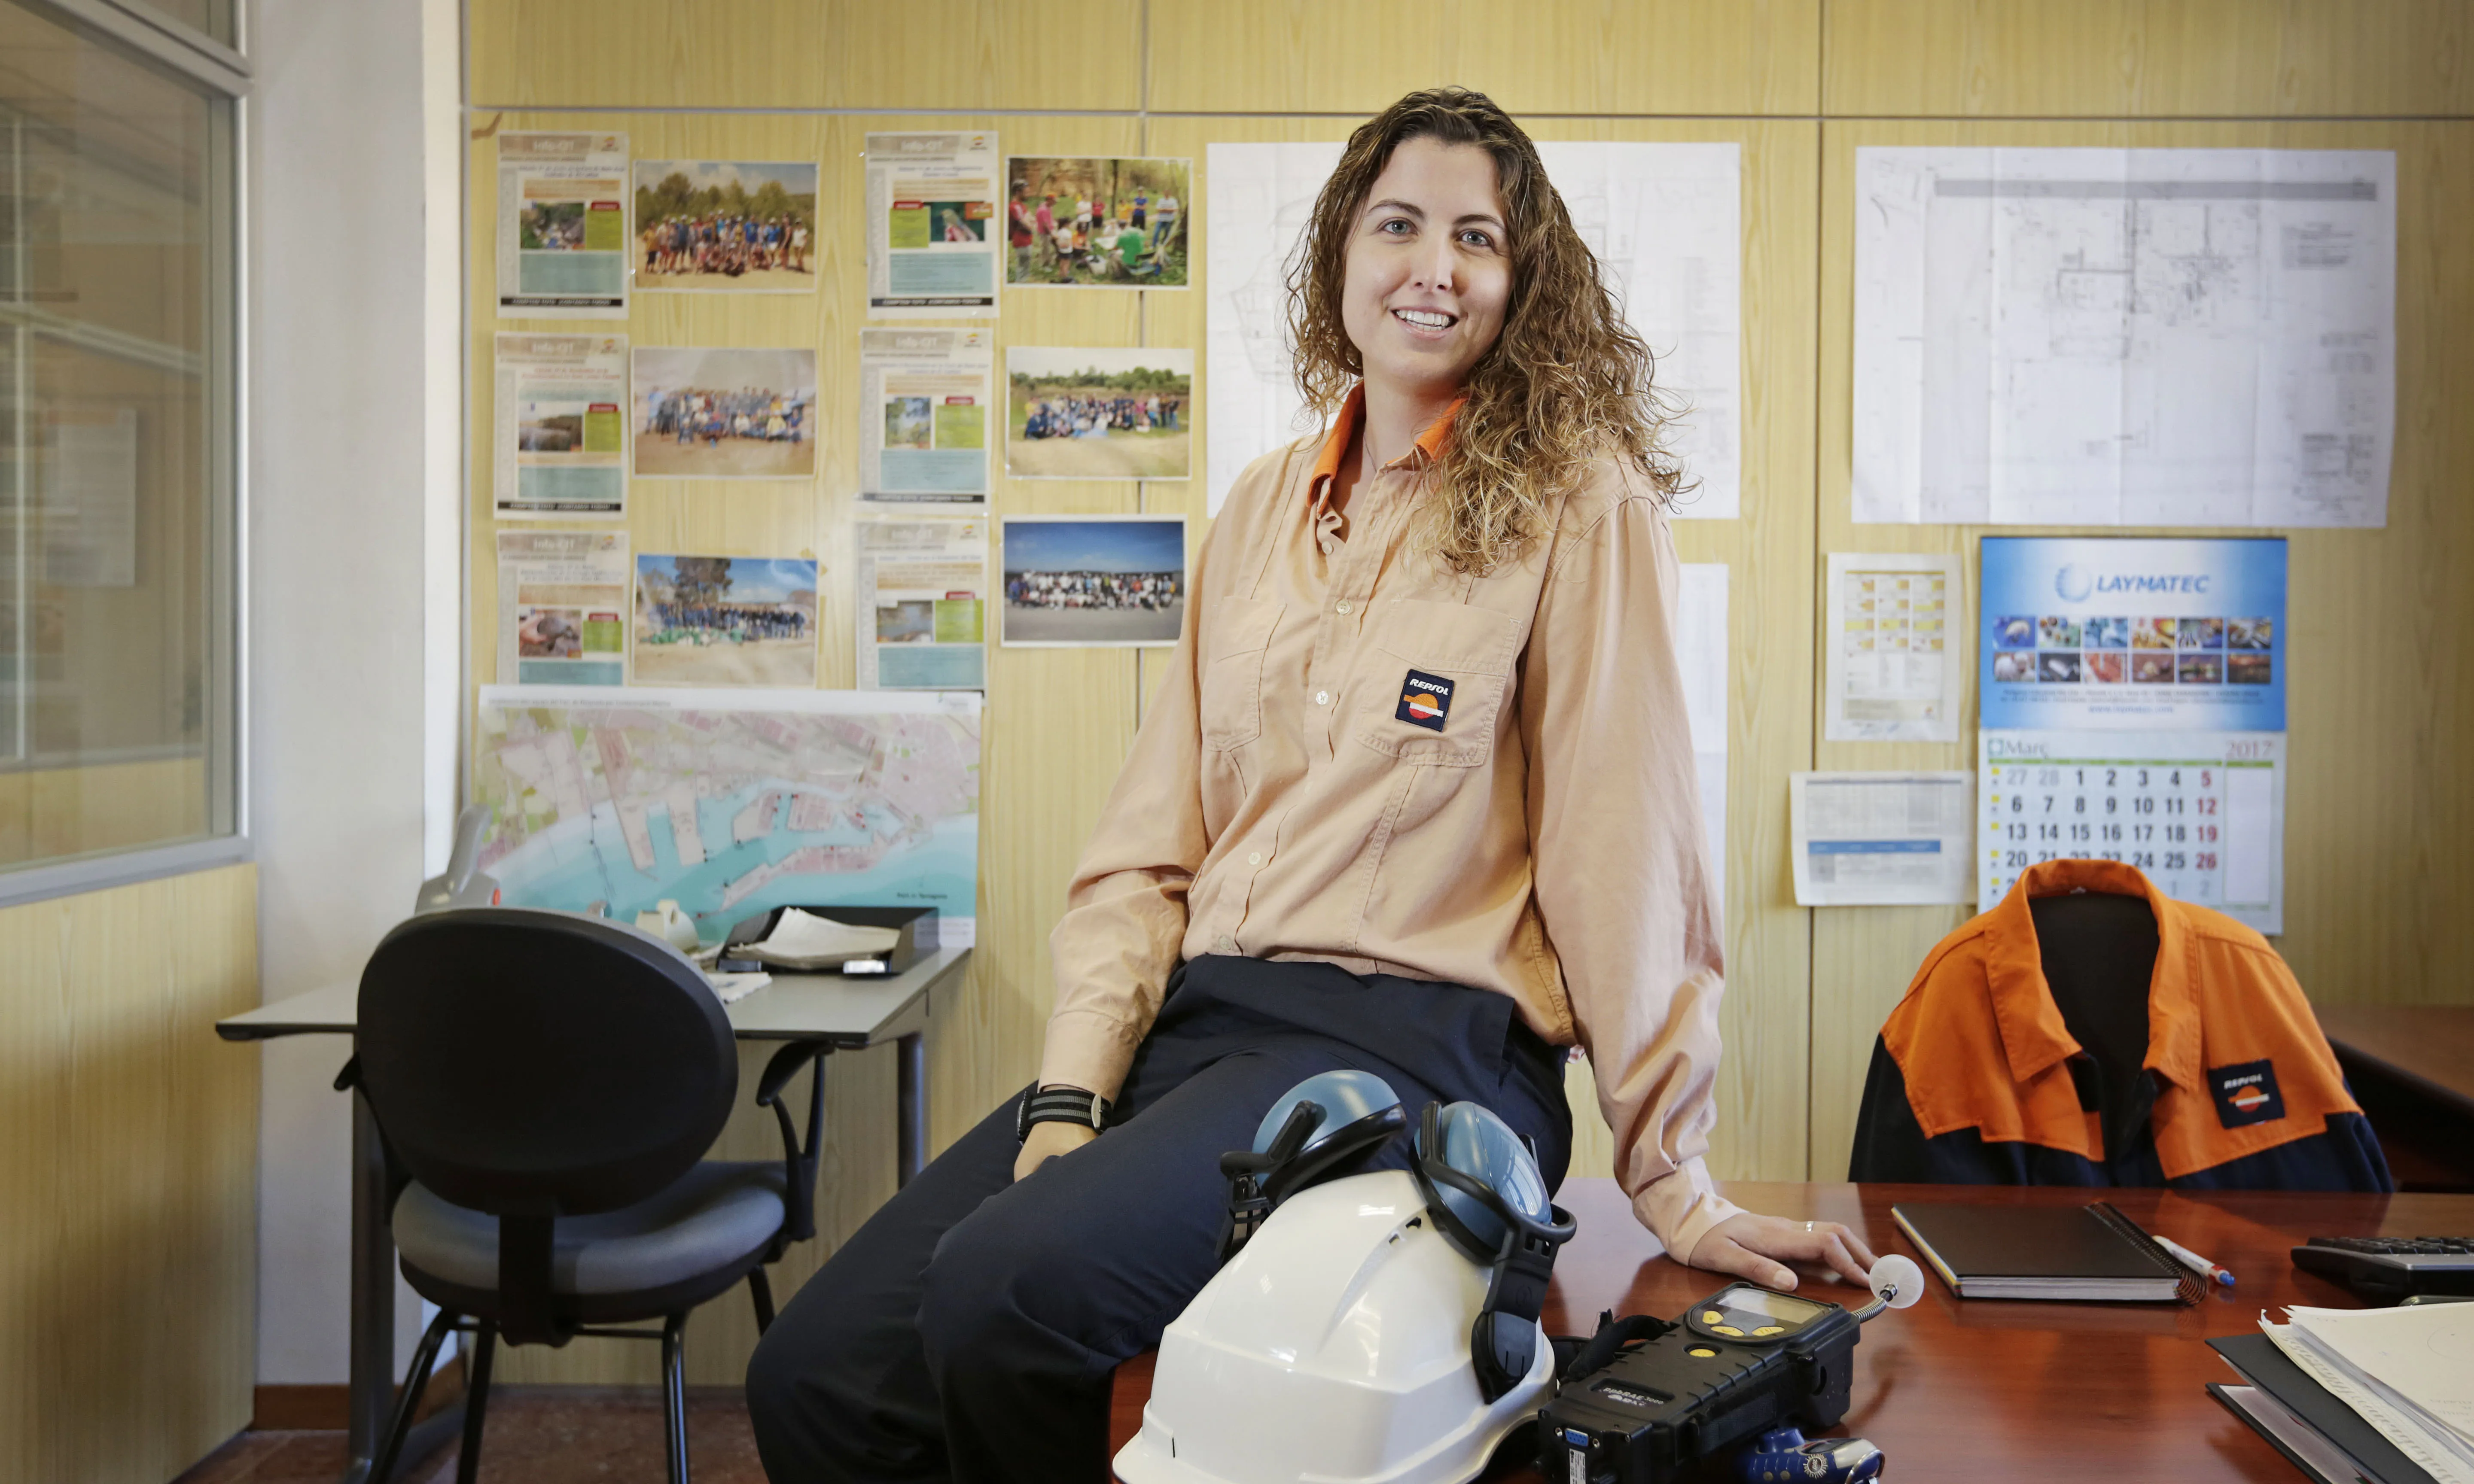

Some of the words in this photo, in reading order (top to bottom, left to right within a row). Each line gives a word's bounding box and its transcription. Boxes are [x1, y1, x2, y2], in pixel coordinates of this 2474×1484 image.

[2097, 575, 2209, 593] LAYMATEC
[1410, 678, 1448, 695] REPSOL
[2005, 740, 2049, 759] Març
[2226, 740, 2272, 759] 2017
[2007, 769, 2027, 785] 27
[2038, 769, 2060, 787] 28
[2076, 769, 2084, 786] 1
[2106, 769, 2117, 787] 2
[2139, 769, 2148, 787] 3
[2170, 770, 2180, 787] 4
[2201, 770, 2212, 788] 5
[2011, 796, 2022, 813] 6
[2044, 796, 2054, 813] 7
[2075, 796, 2085, 814] 8
[2106, 796, 2117, 814] 9
[2133, 797, 2154, 815] 10
[2166, 797, 2183, 815] 11
[2197, 797, 2217, 815] 12
[2008, 823, 2026, 840] 13
[2039, 824, 2059, 840] 14
[2071, 824, 2090, 841] 15
[2102, 824, 2121, 841] 16
[2133, 824, 2153, 842] 17
[2166, 824, 2186, 842] 18
[2198, 825, 2218, 843] 19
[2007, 851, 2027, 867] 20
[2133, 852, 2153, 868] 24
[2165, 852, 2186, 869] 25
[2196, 852, 2217, 870] 26
[2224, 1074, 2262, 1089] REPSOL
